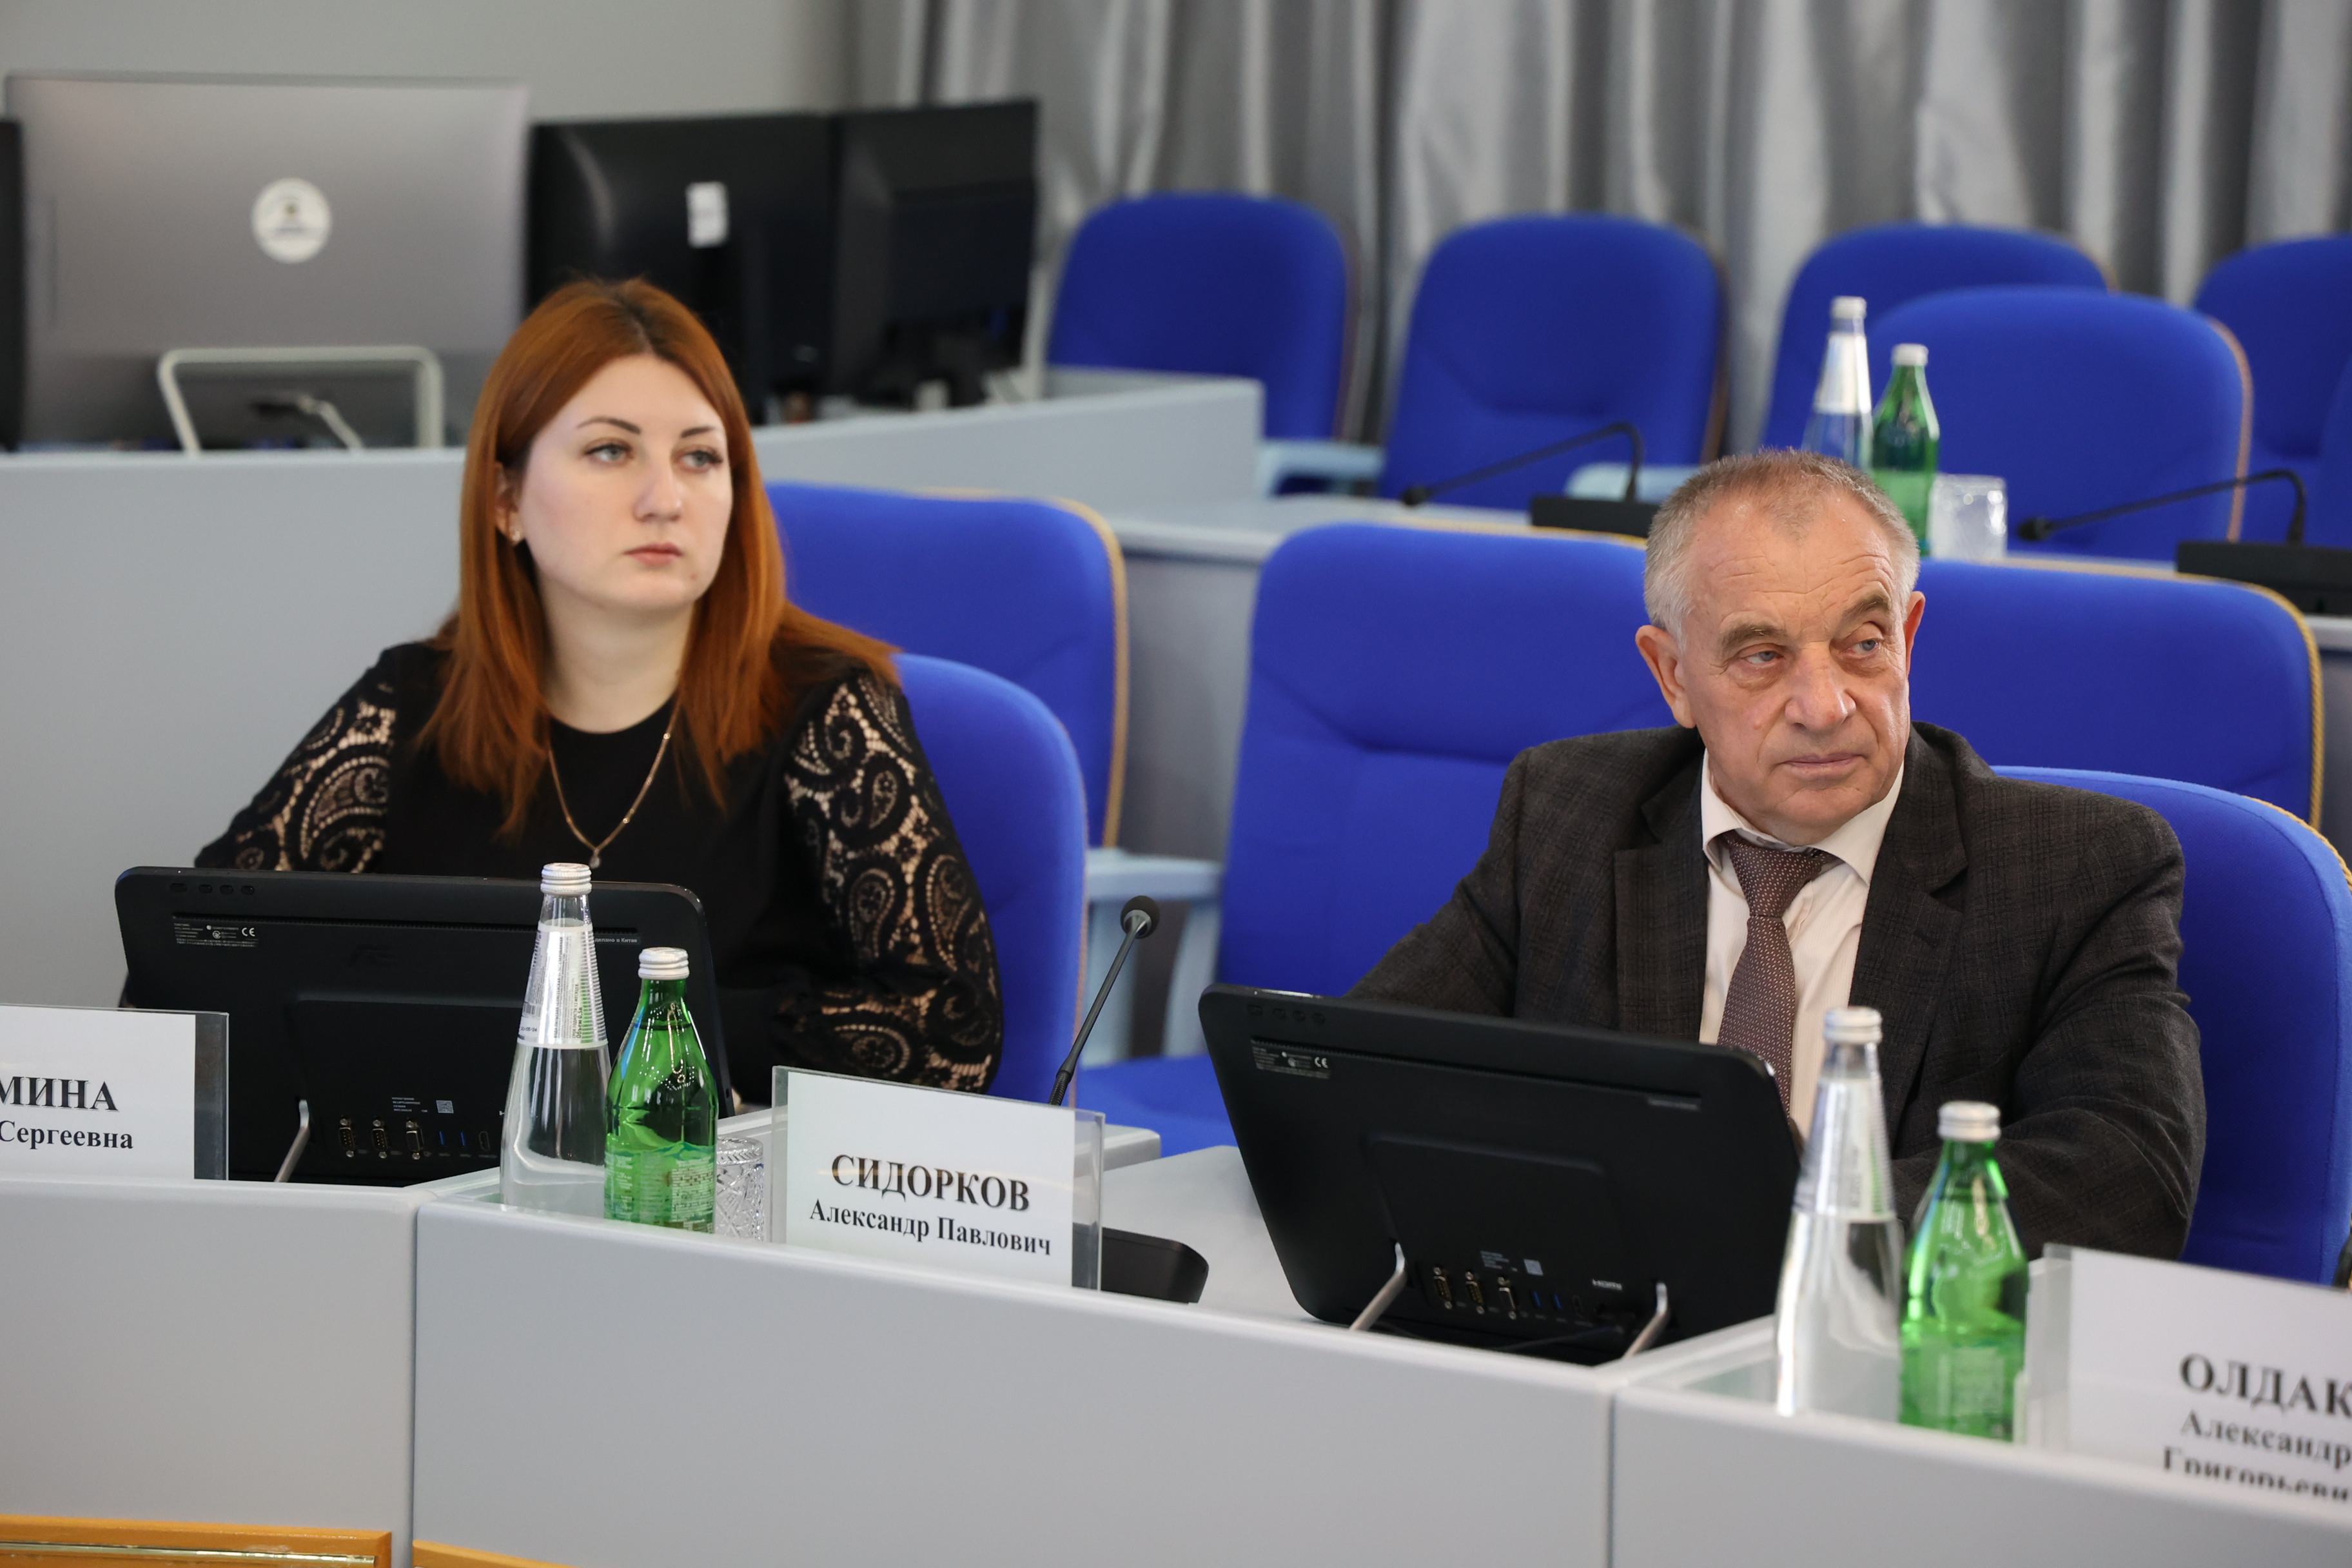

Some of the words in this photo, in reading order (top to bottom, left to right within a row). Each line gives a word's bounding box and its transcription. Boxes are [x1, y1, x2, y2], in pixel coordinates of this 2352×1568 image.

[0, 1076, 119, 1112] МИНА
[0, 1120, 133, 1150] Сергеевна
[831, 1154, 1030, 1211] СИДОРКОВ
[809, 1199, 930, 1242] Александр
[937, 1216, 1052, 1256] Павлович
[2179, 1353, 2352, 1418] ОЛДАК
[2180, 1409, 2352, 1471] Александр
